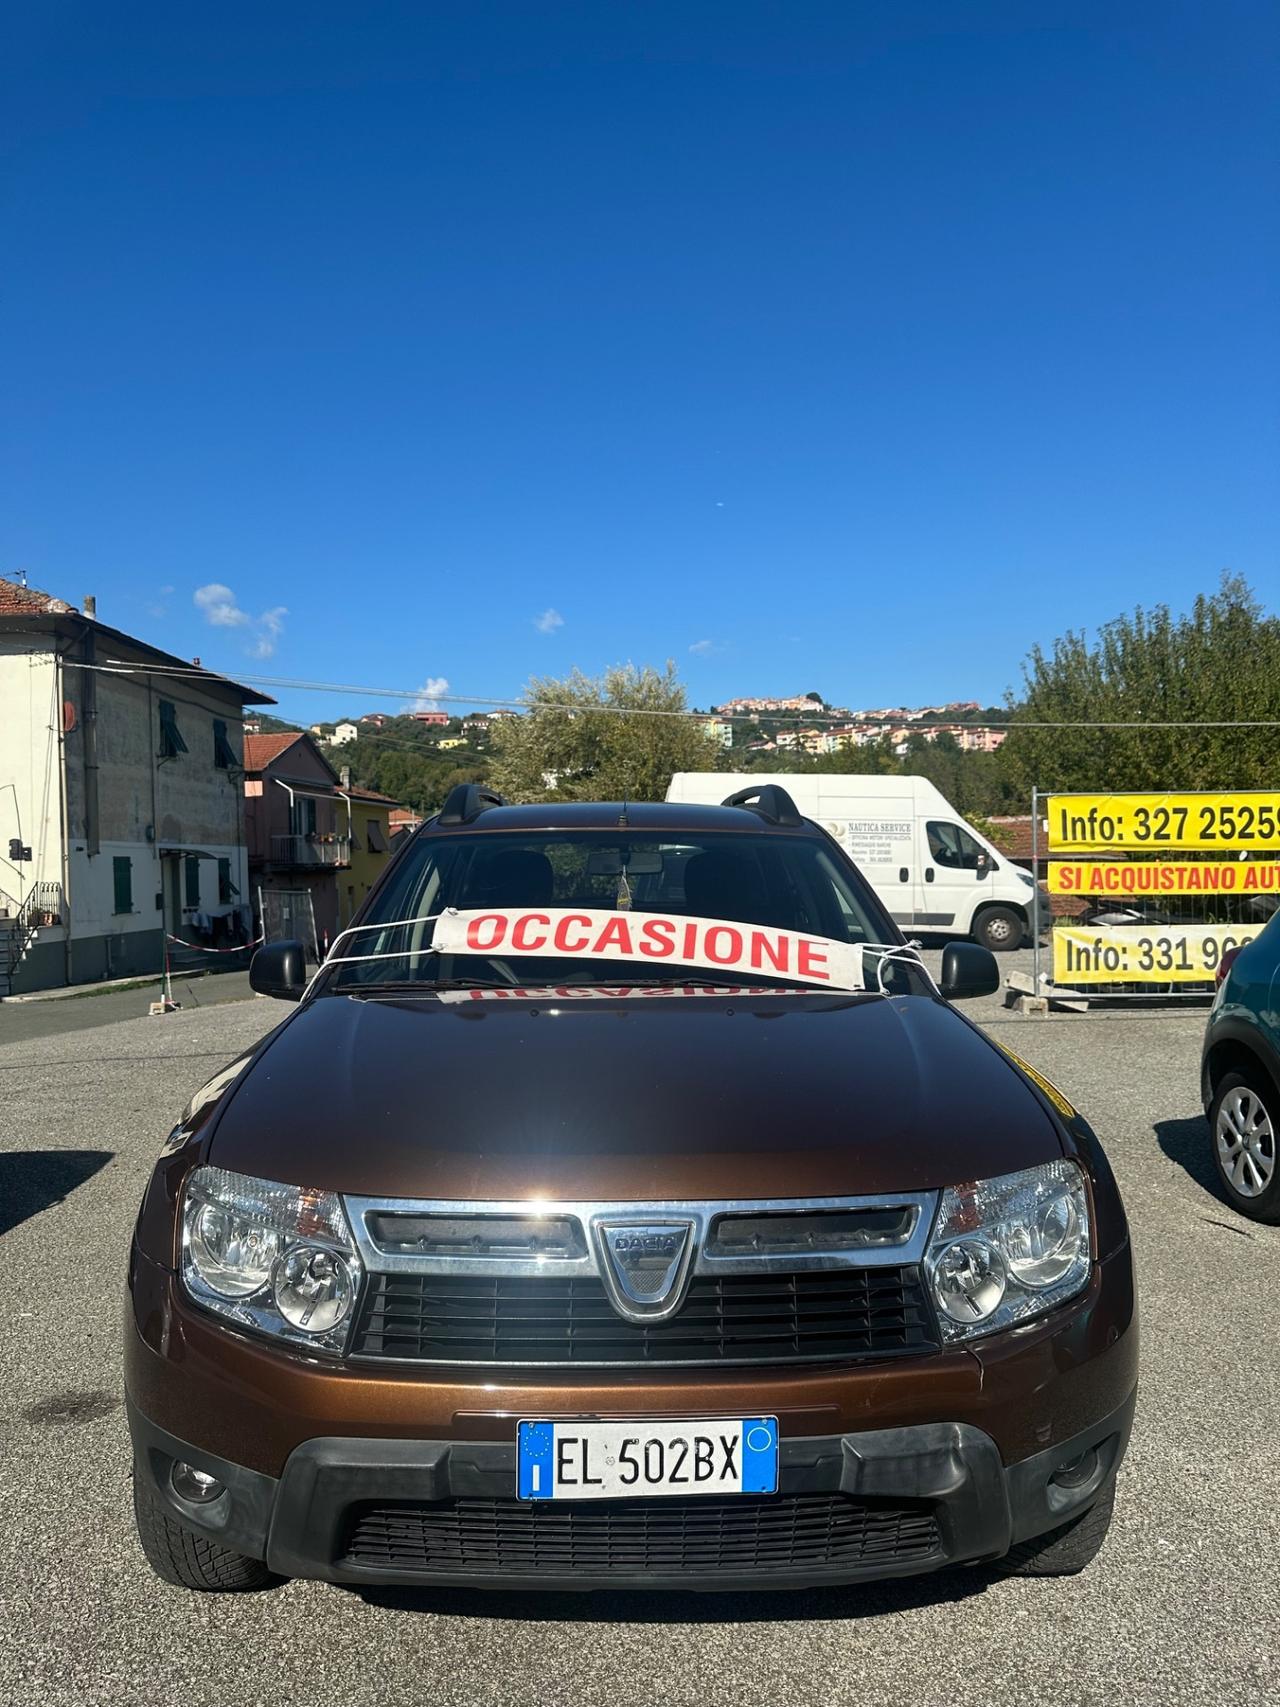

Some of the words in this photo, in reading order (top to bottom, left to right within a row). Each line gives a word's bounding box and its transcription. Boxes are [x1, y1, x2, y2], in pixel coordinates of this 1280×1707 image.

[848, 823, 879, 832] NAUTICA
[880, 823, 911, 832] SERVICE
[1061, 807, 1124, 841] Info:
[1133, 807, 1189, 841] 327
[1199, 806, 1280, 840] 2525
[1059, 866, 1081, 890] SI
[1089, 866, 1236, 892] ACQUISTANO
[466, 914, 831, 980] OCCASIONE
[1066, 938, 1129, 972] Info:
[1137, 937, 1194, 971] 331
[616, 1238, 677, 1250] DACIA
[557, 1438, 602, 1485] EL
[618, 1435, 740, 1484] 502BX
[532, 1464, 540, 1492] I
